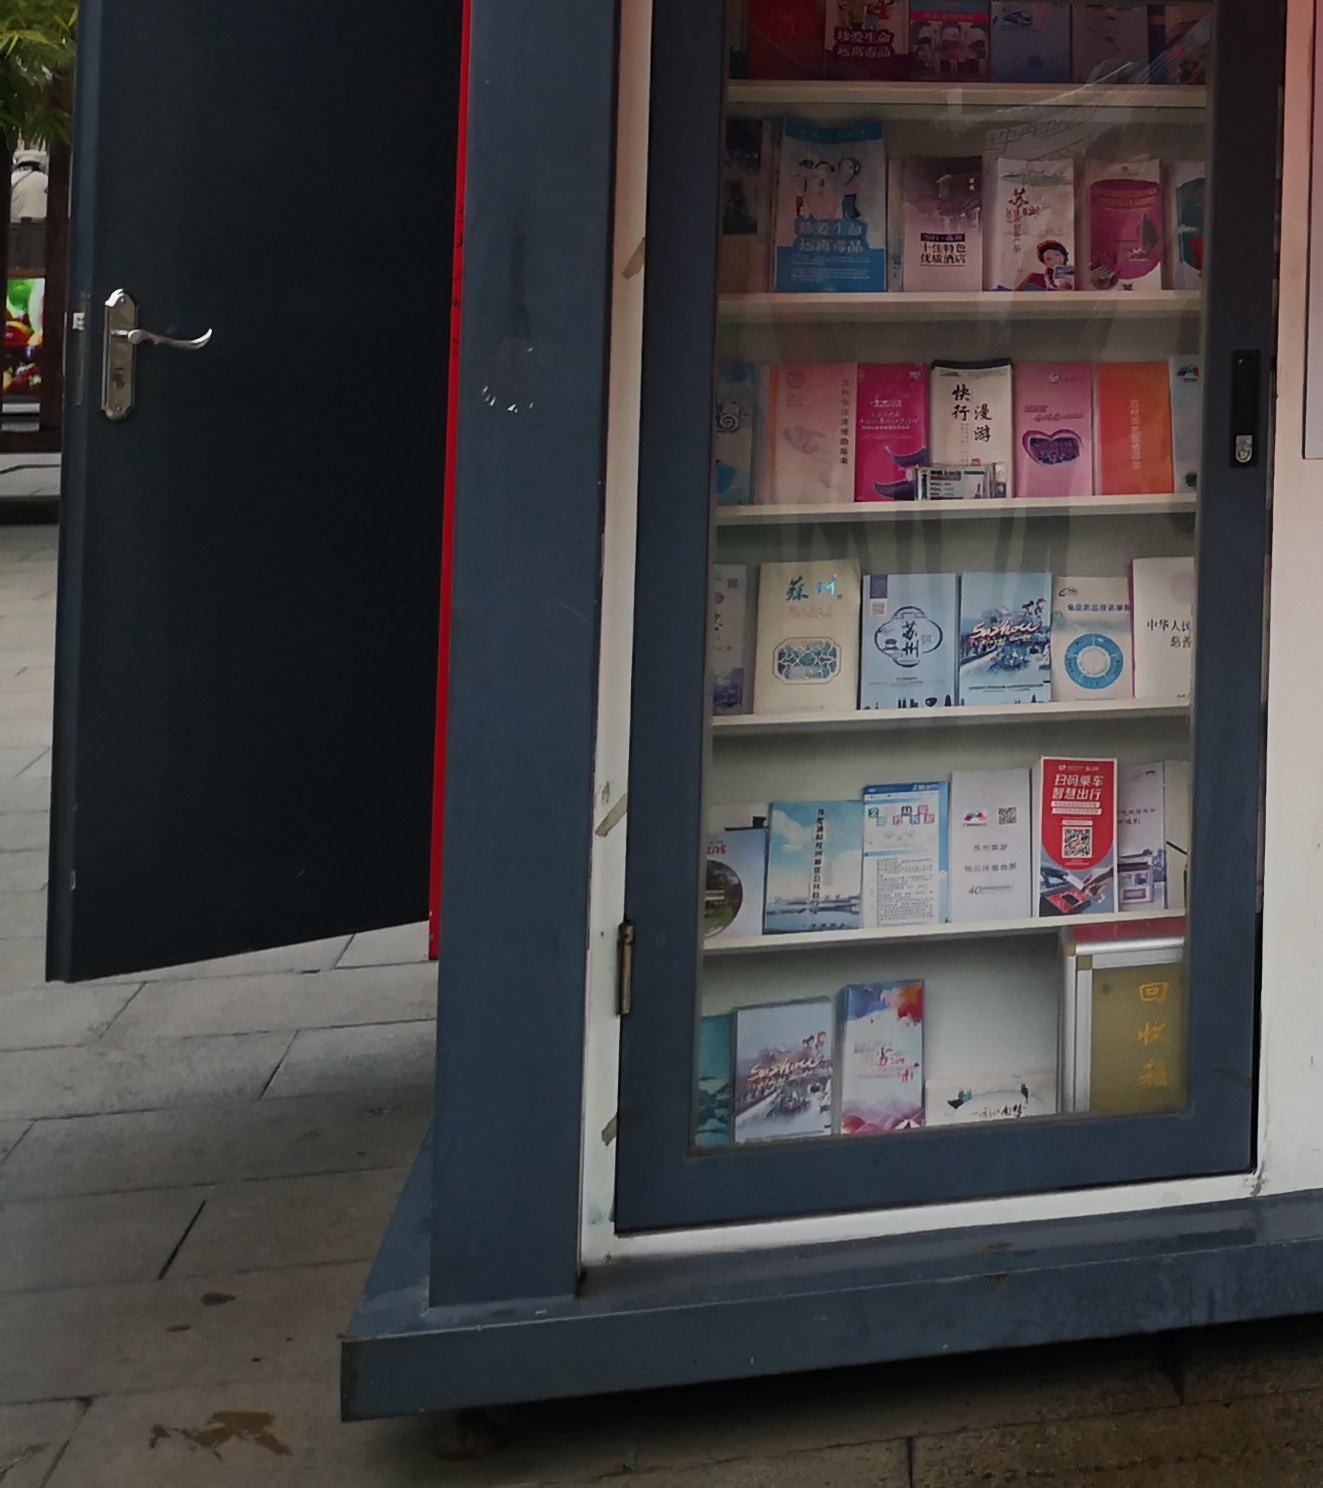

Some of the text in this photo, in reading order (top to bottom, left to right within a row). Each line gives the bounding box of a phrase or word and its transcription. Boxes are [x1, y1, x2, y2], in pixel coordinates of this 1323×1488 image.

[952, 383, 970, 421] 快行
[973, 403, 993, 443] 漫游
[1054, 774, 1104, 787] 扫码乘车
[1052, 787, 1102, 801] 智慧出行
